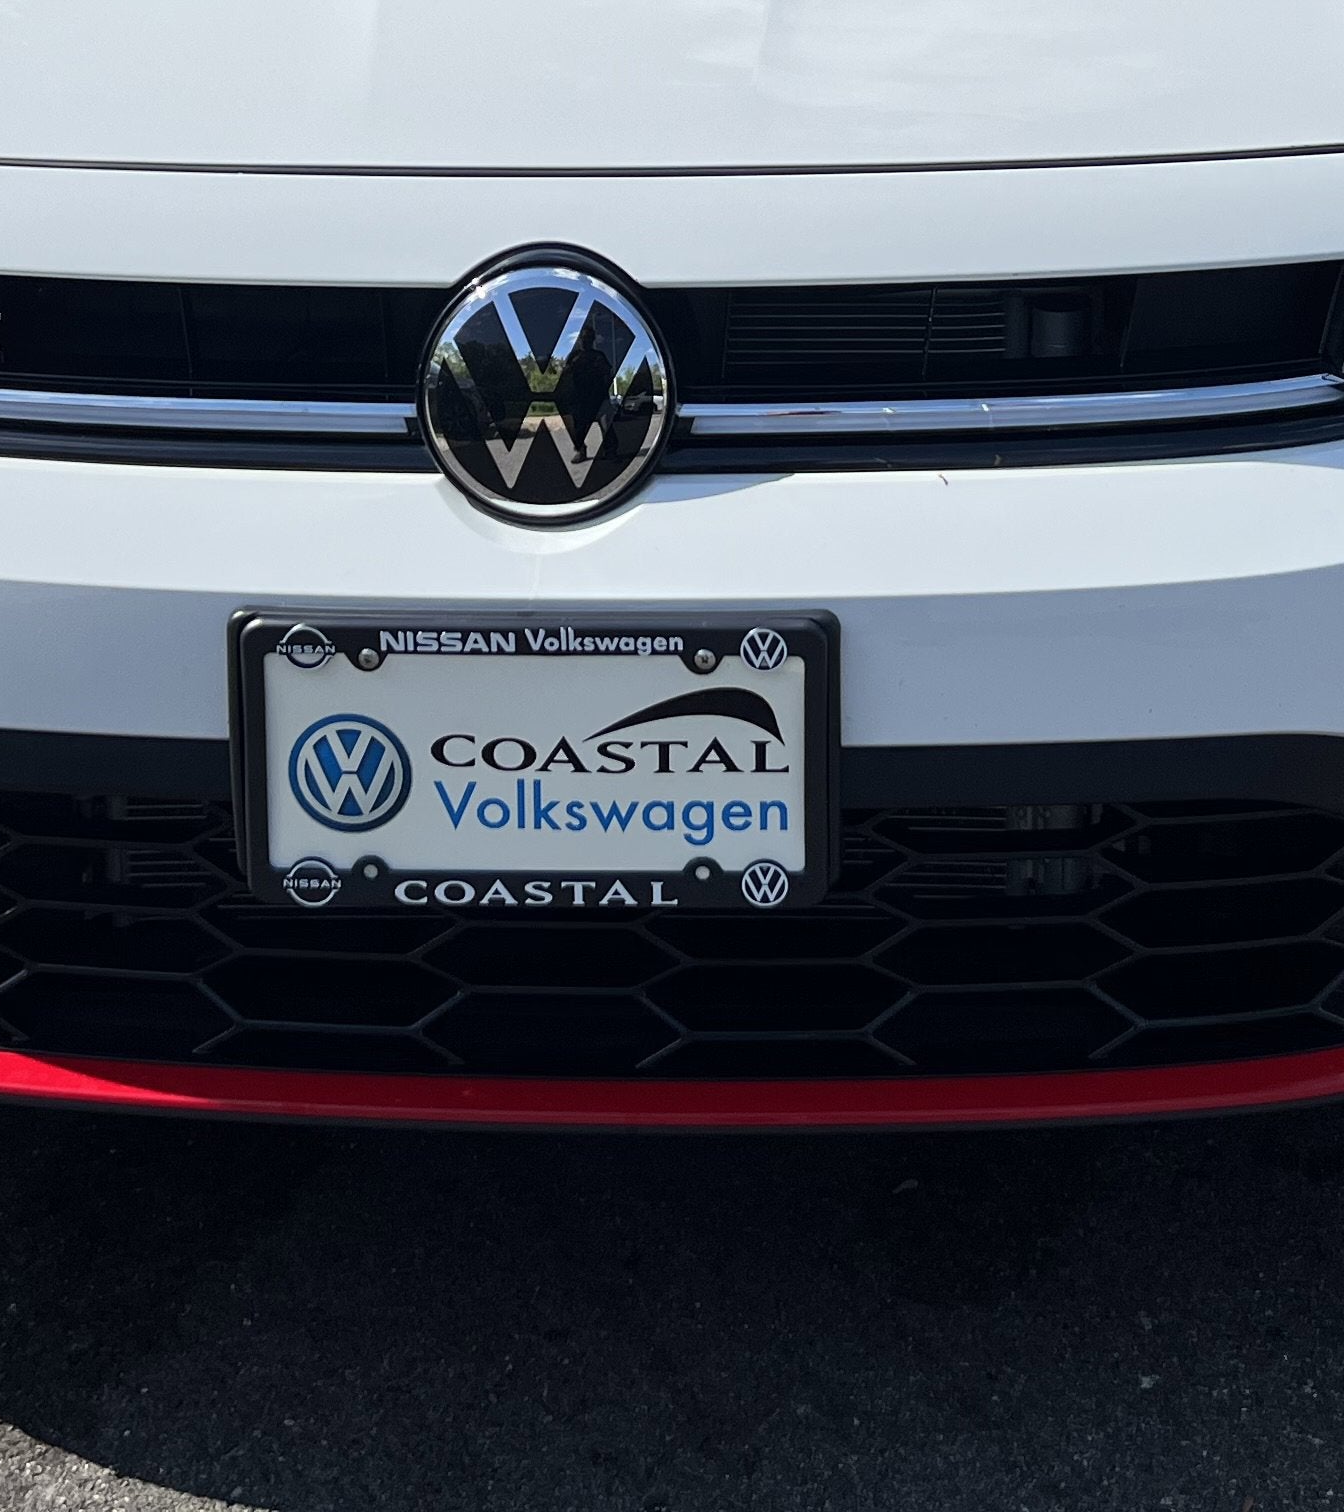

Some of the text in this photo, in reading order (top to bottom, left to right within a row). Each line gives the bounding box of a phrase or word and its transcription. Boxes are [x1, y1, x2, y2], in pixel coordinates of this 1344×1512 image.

[276, 644, 336, 655] NISSAN
[380, 627, 684, 656] NISSAN Volkswagen
[430, 734, 790, 775] COASTAL
[433, 777, 788, 846] Volkswagen
[282, 878, 342, 890] NISSAN
[394, 879, 679, 907] COASTAL
